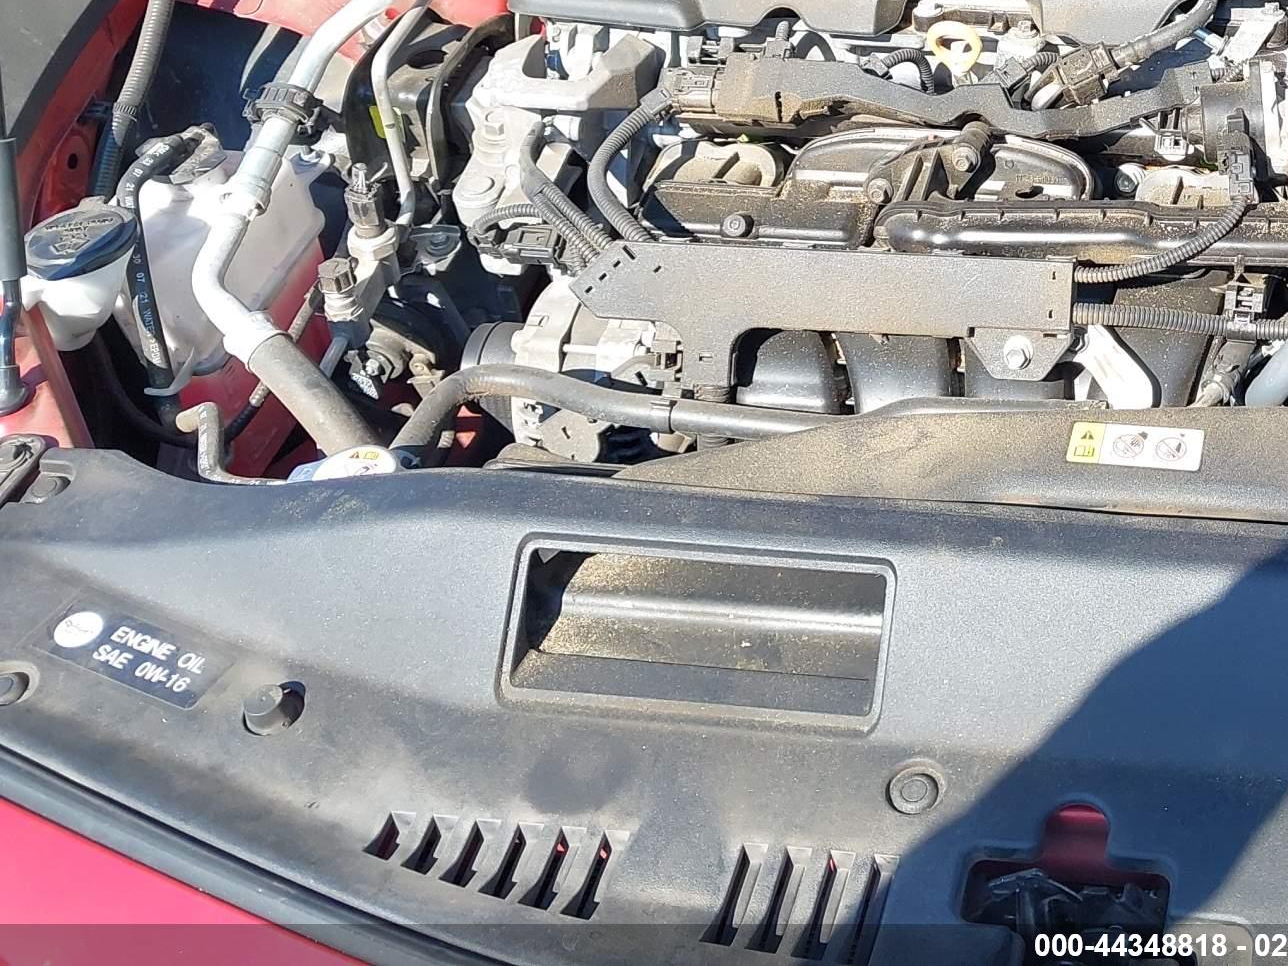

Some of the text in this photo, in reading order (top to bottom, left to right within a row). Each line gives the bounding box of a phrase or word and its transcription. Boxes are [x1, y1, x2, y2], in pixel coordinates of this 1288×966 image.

[92, 644, 191, 692] SAE 0W-16
[110, 626, 206, 674] ENGINE OIL
